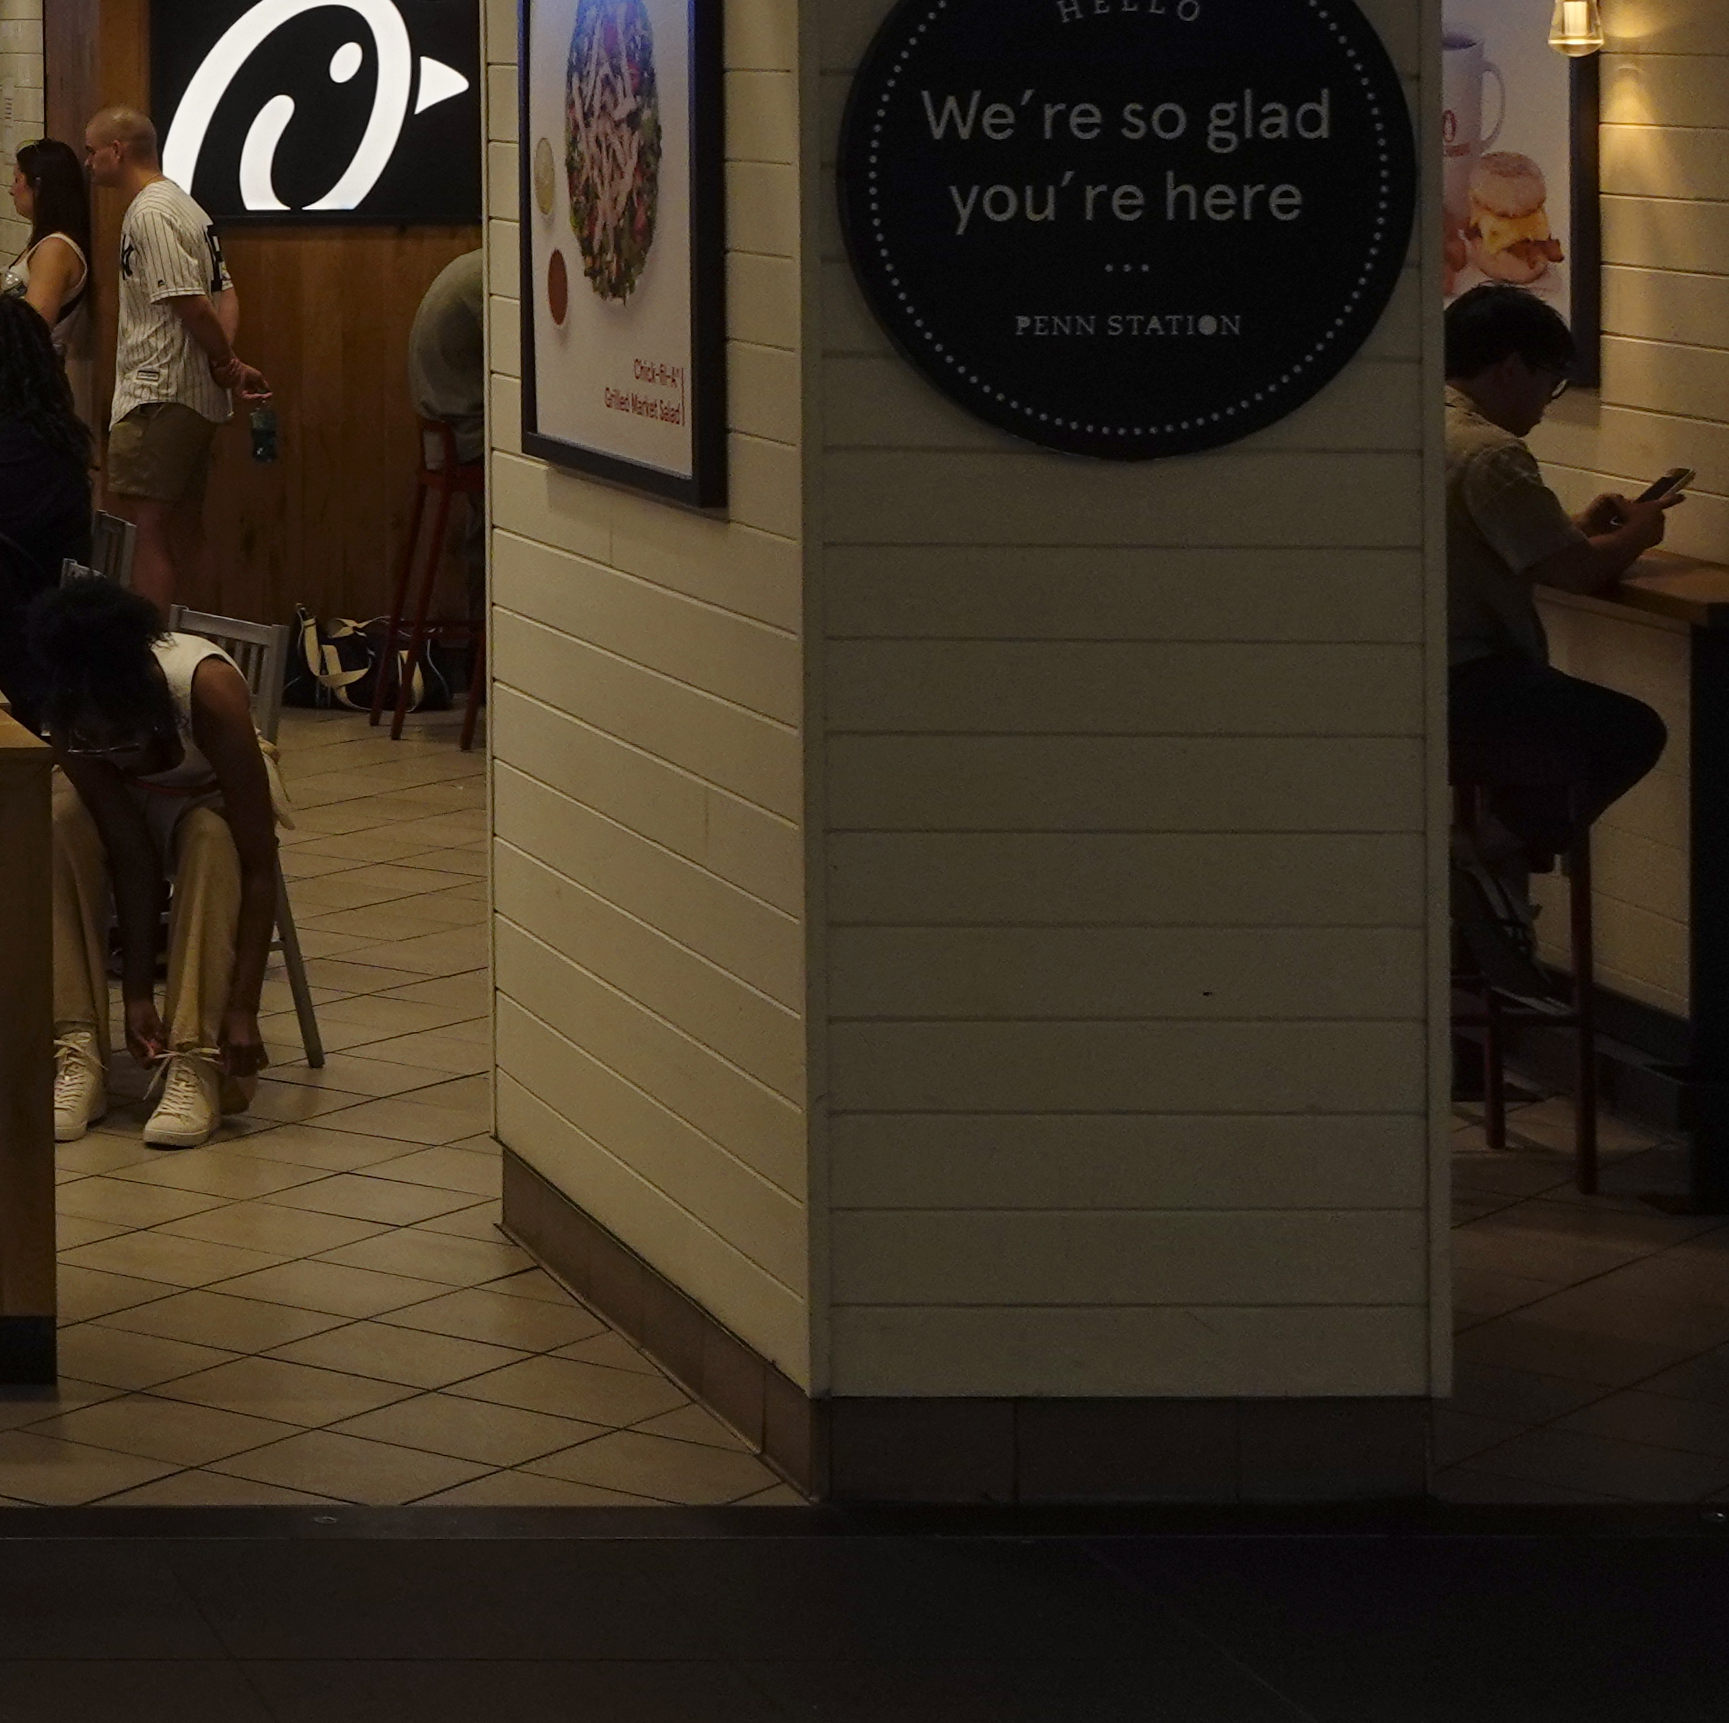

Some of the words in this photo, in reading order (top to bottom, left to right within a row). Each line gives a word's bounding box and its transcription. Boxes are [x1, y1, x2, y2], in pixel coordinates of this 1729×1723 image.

[920, 88, 1103, 141] We're
[1120, 101, 1187, 141] so
[1206, 88, 1332, 155] glad
[948, 169, 1144, 236] you're
[1166, 169, 1304, 222] here
[1015, 315, 1097, 337] PENN
[1107, 314, 1242, 337] STATION
[604, 386, 630, 414] Grilled
[631, 392, 658, 420] Market
[659, 398, 681, 425] Salad
